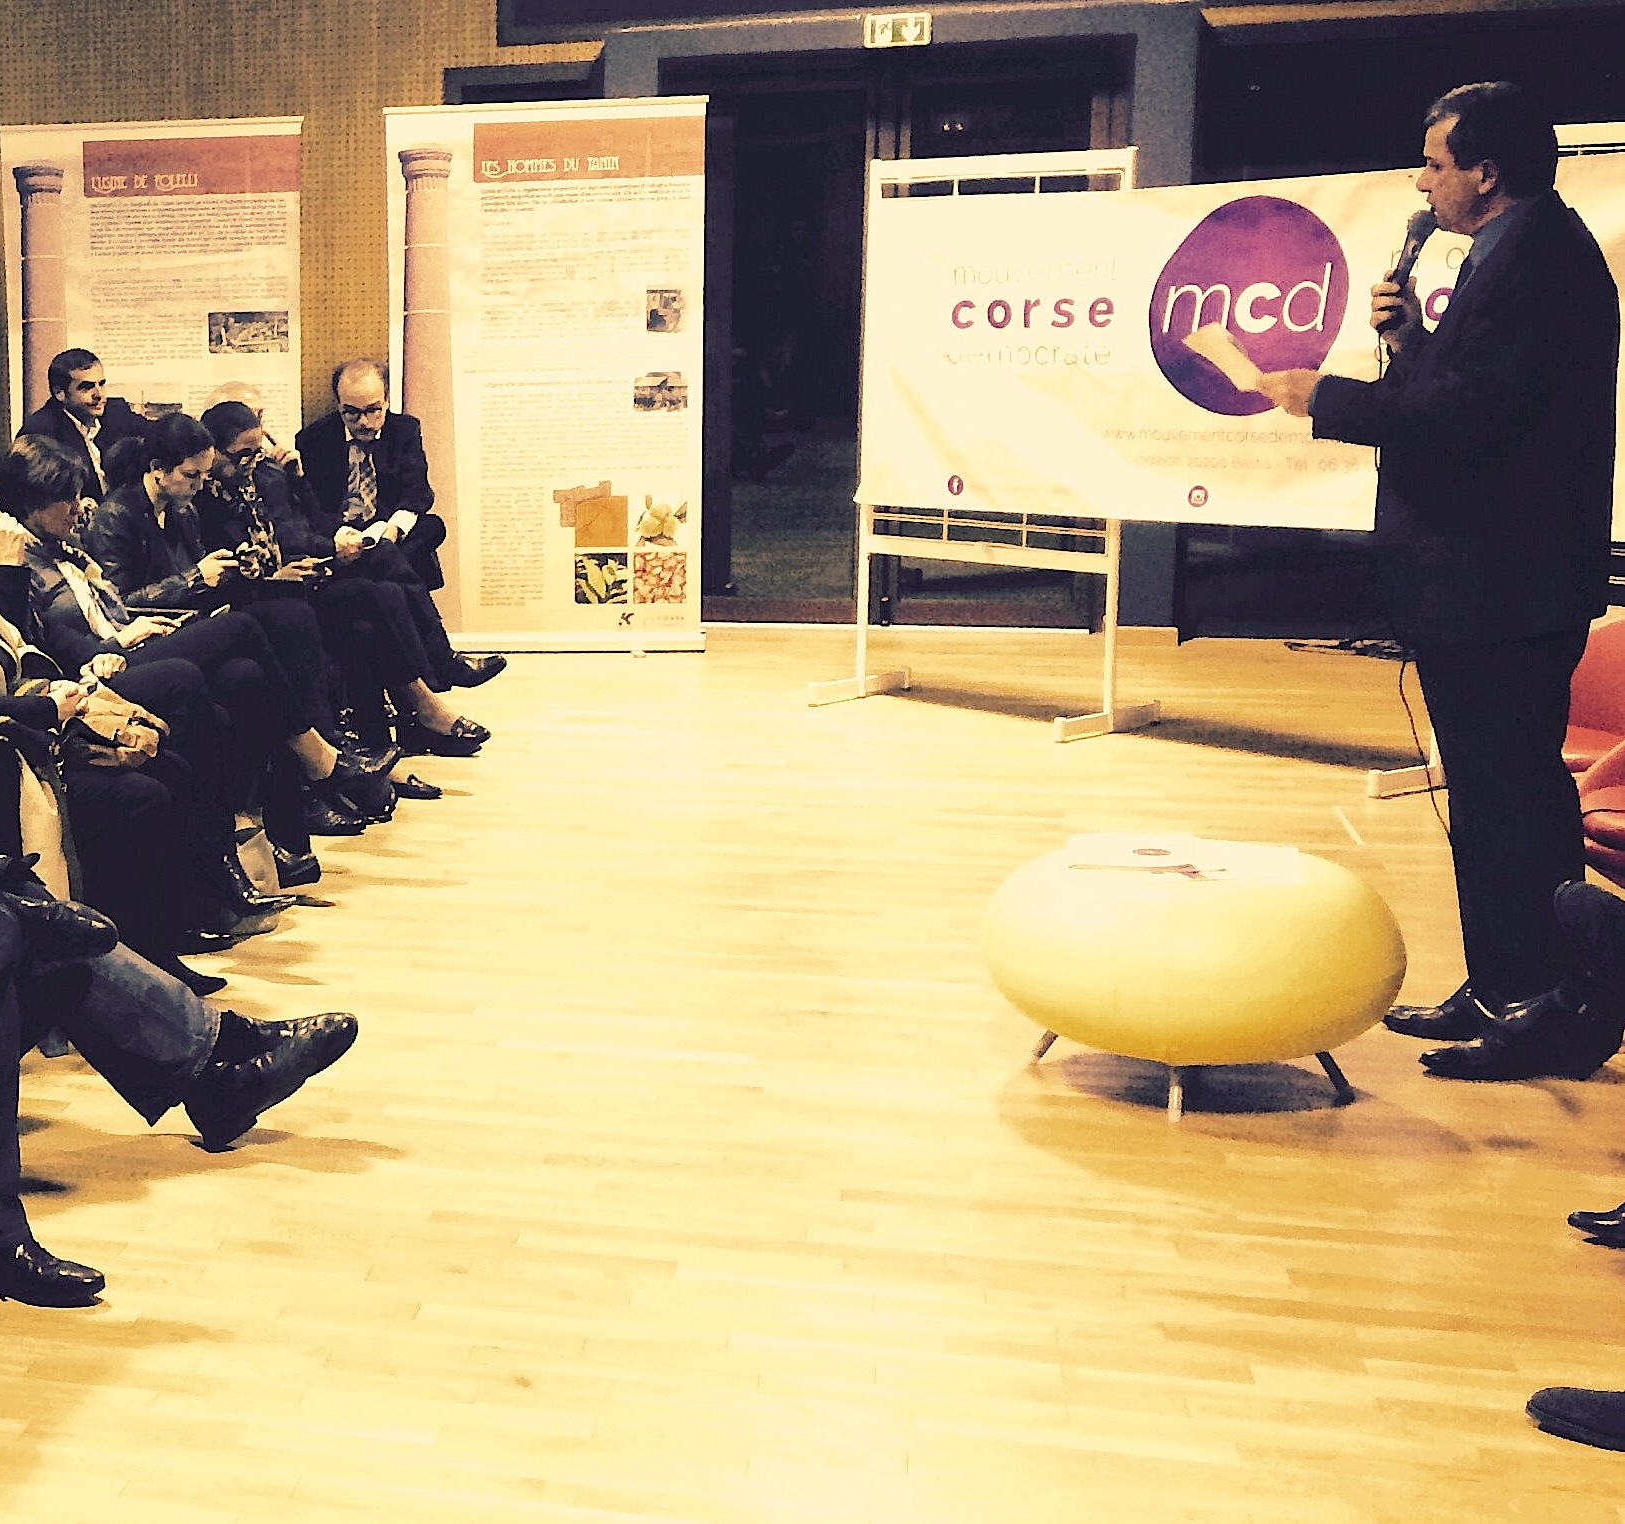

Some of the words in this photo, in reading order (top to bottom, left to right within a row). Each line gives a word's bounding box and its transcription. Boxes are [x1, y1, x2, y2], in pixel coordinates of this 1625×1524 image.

[481, 160, 505, 178] LES
[507, 157, 557, 175] HOMMES
[563, 157, 580, 172] DU
[587, 155, 620, 171] TANIN
[134, 174, 148, 189] DE
[1162, 261, 1332, 334] mcd
[951, 296, 1115, 329] corse
